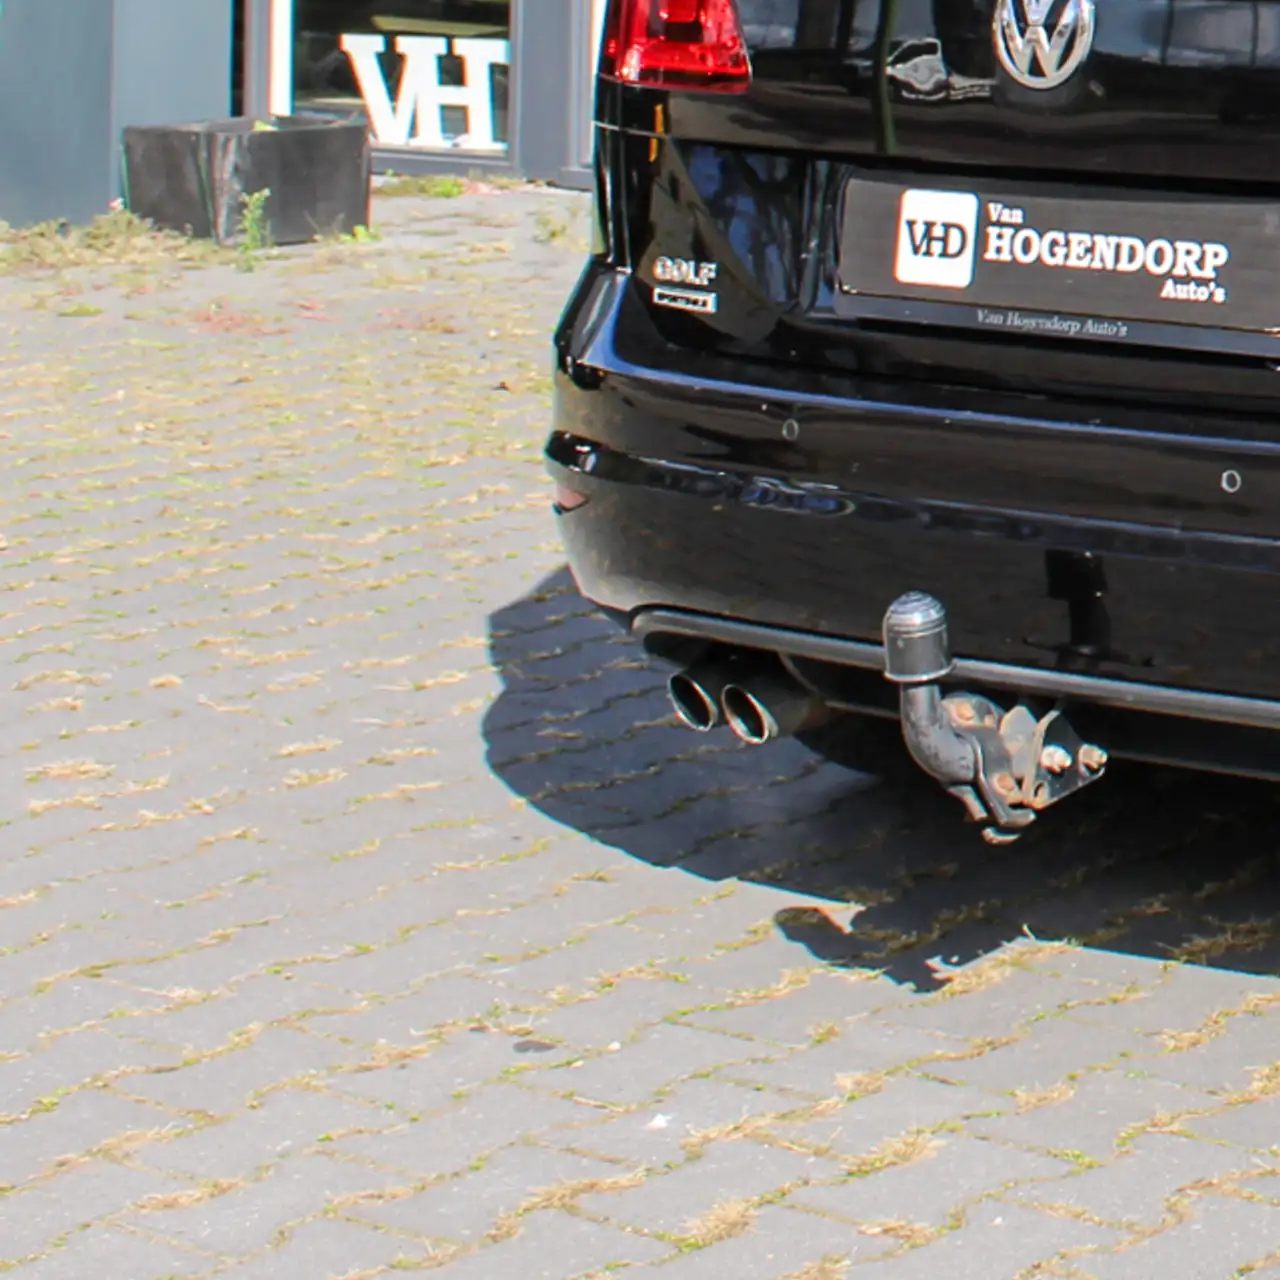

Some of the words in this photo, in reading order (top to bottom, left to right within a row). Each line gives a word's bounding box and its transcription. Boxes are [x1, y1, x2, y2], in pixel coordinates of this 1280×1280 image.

[986, 202, 1024, 224] Van
[906, 219, 968, 259] VHD
[983, 225, 1229, 280] HOGENDORP
[653, 256, 717, 286] GOLF
[1159, 278, 1227, 304] Auto's
[976, 309, 1004, 324] Van
[1082, 319, 1128, 337] Auto's
